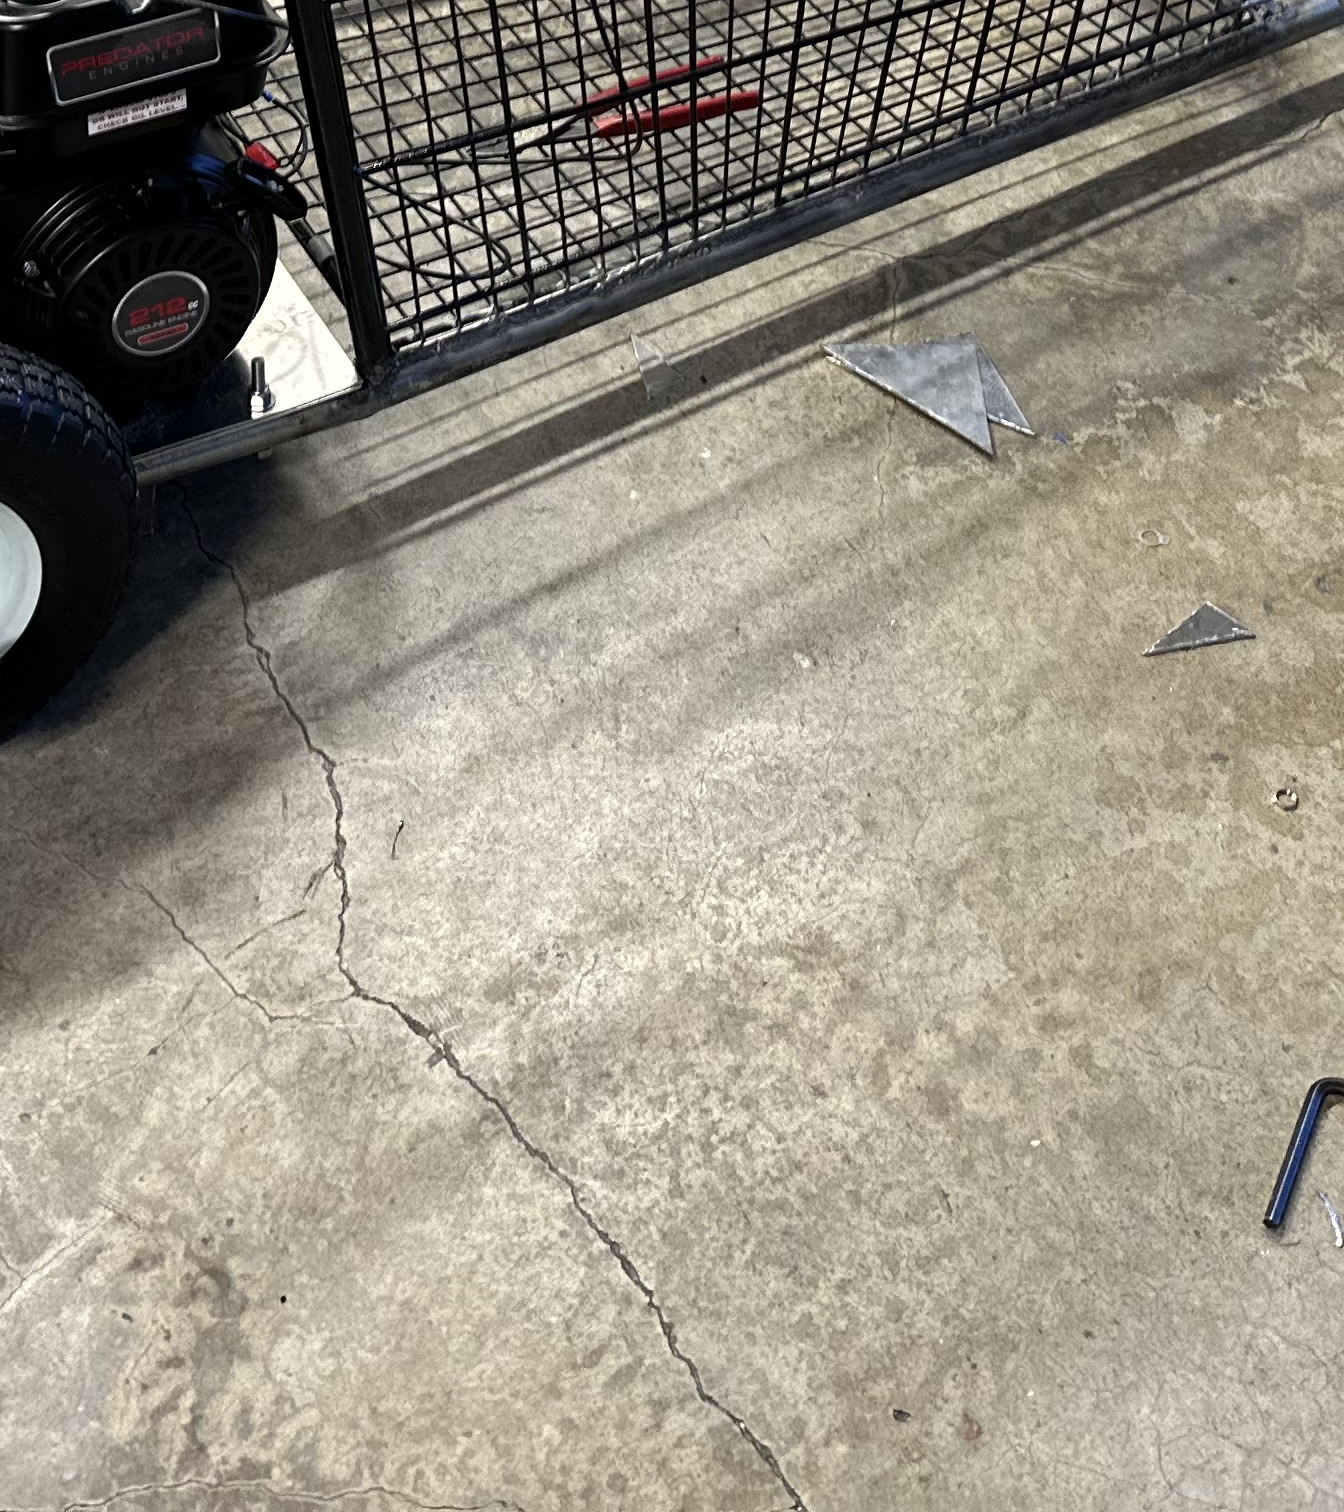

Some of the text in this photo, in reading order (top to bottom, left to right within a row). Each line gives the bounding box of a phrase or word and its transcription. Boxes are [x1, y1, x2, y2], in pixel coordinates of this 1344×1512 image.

[61, 26, 206, 78] PREDATOR
[88, 45, 184, 81] ENGINES
[129, 295, 188, 328] 212
